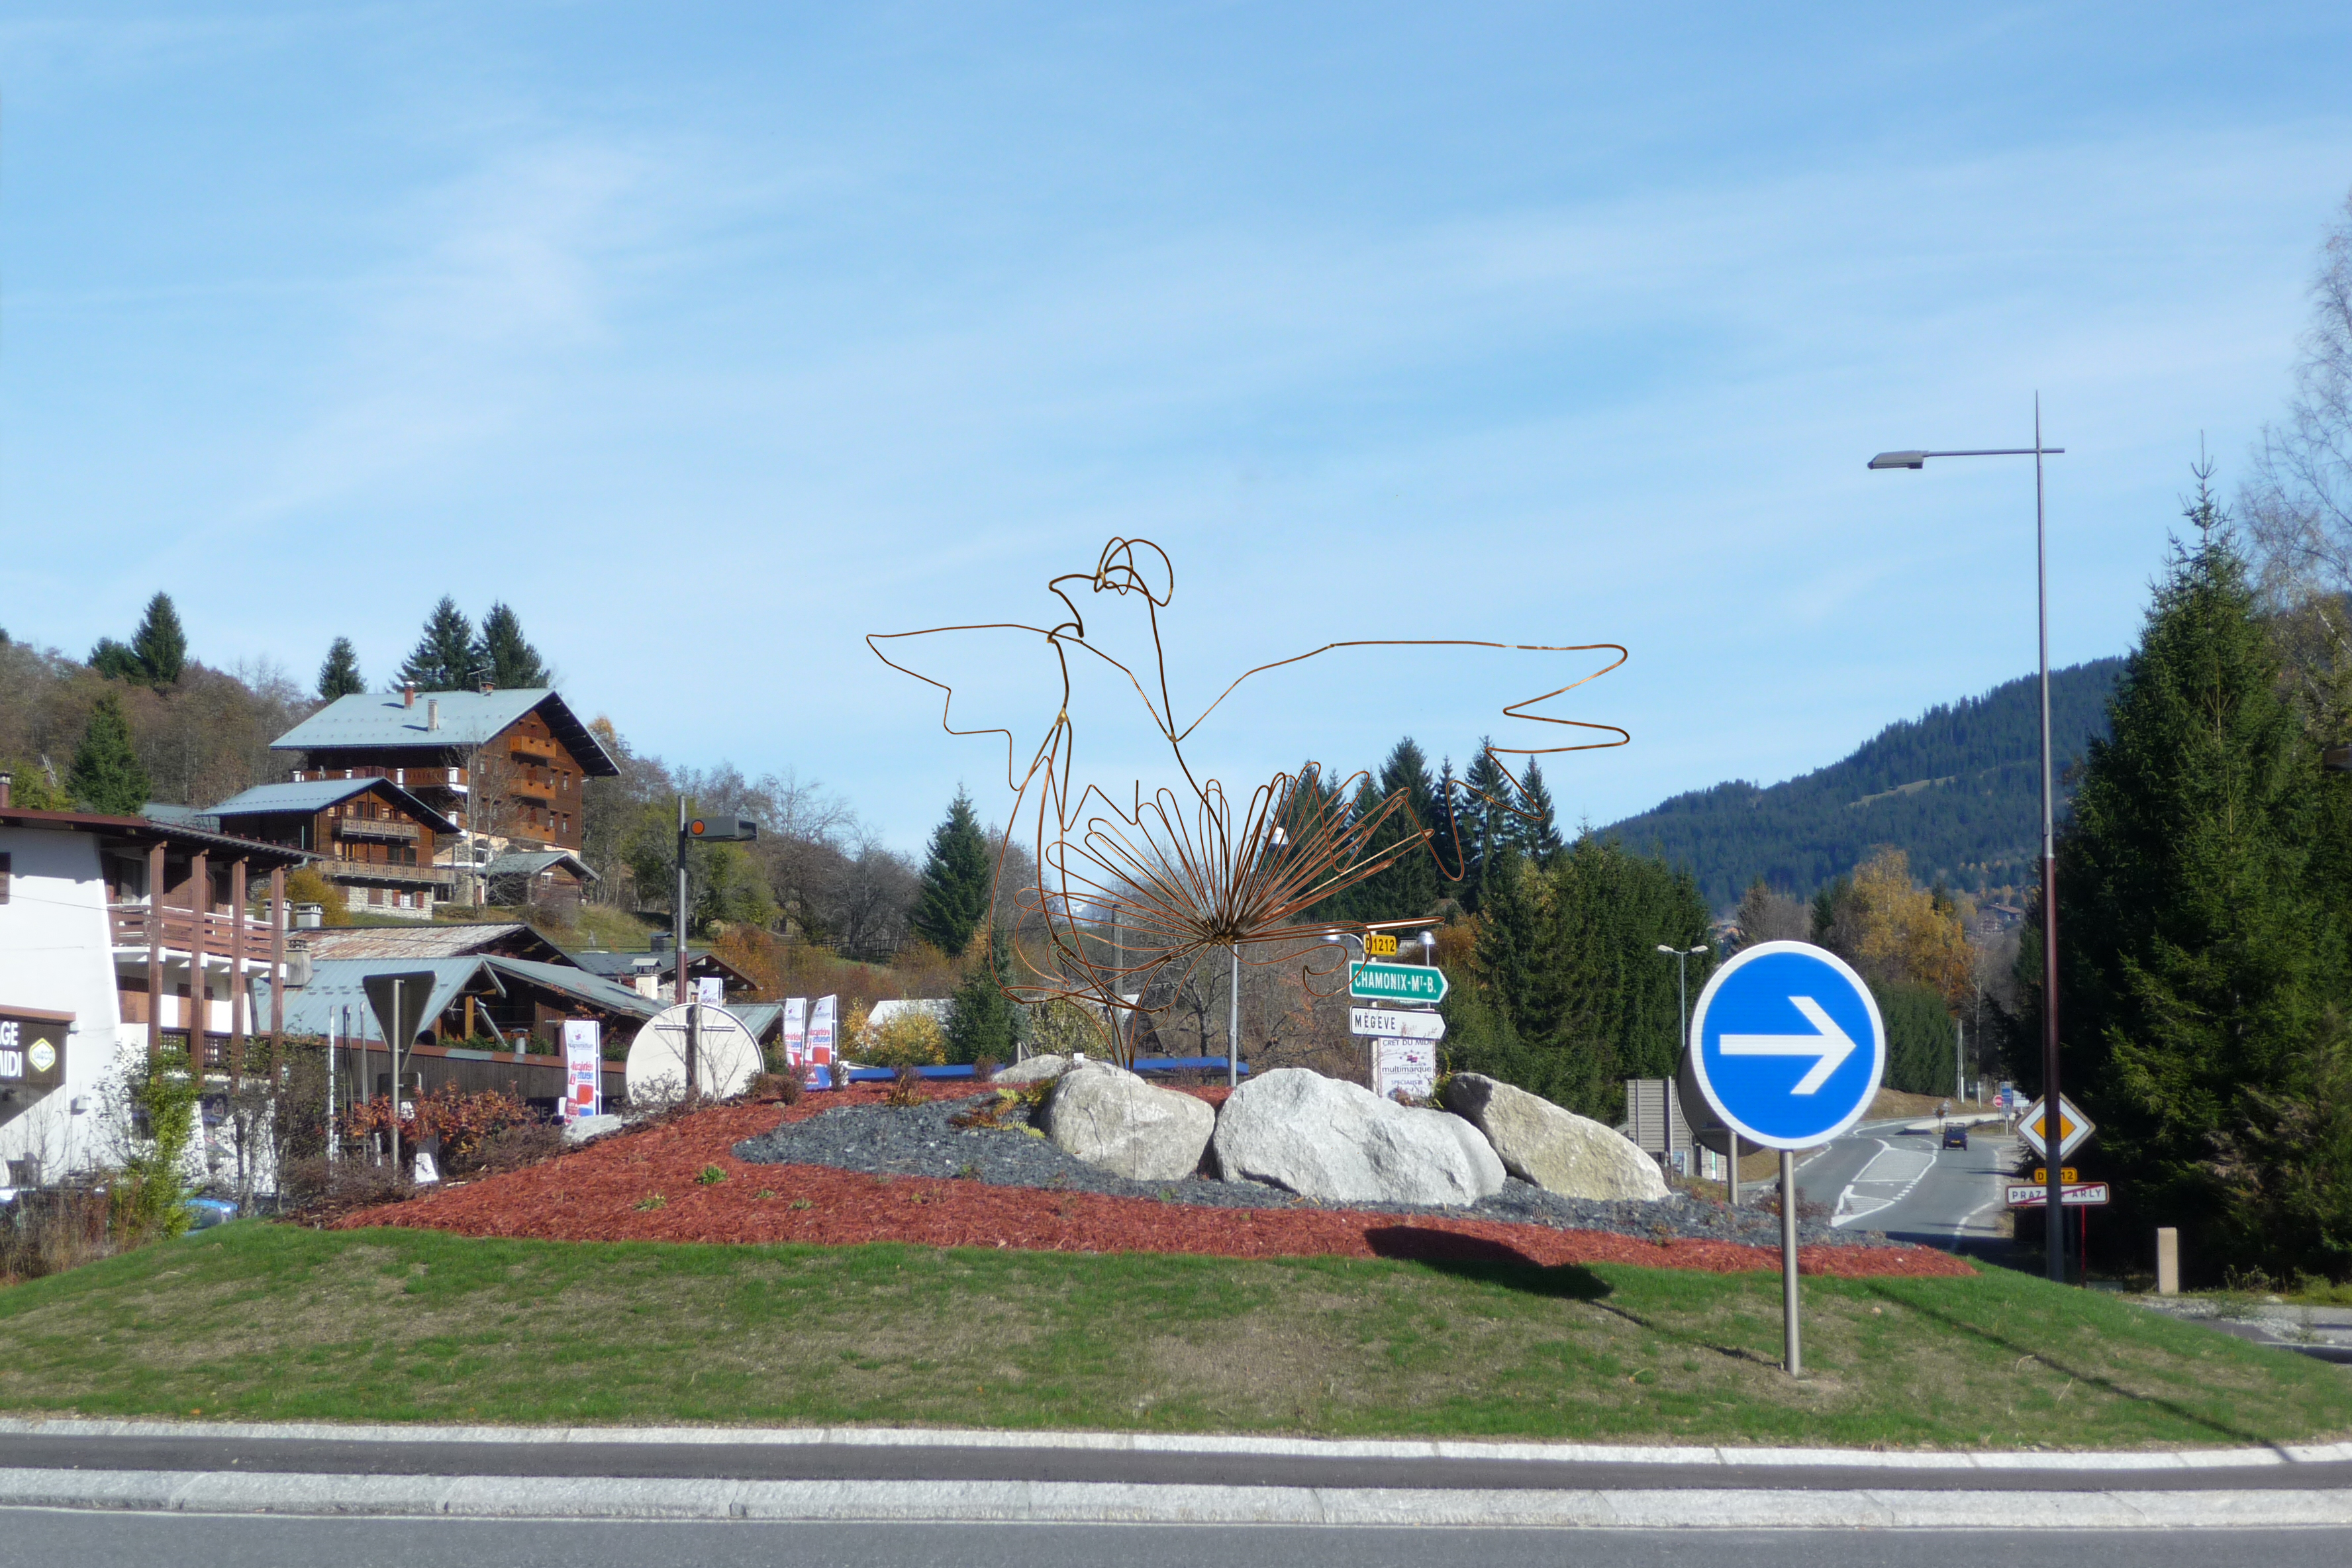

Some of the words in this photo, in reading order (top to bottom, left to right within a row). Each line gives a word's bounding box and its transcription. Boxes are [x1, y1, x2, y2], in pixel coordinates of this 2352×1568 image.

[0, 1021, 18, 1046] GE
[2012, 1191, 2041, 1199] PRAZ
[2072, 1189, 2102, 1198] ARLY
